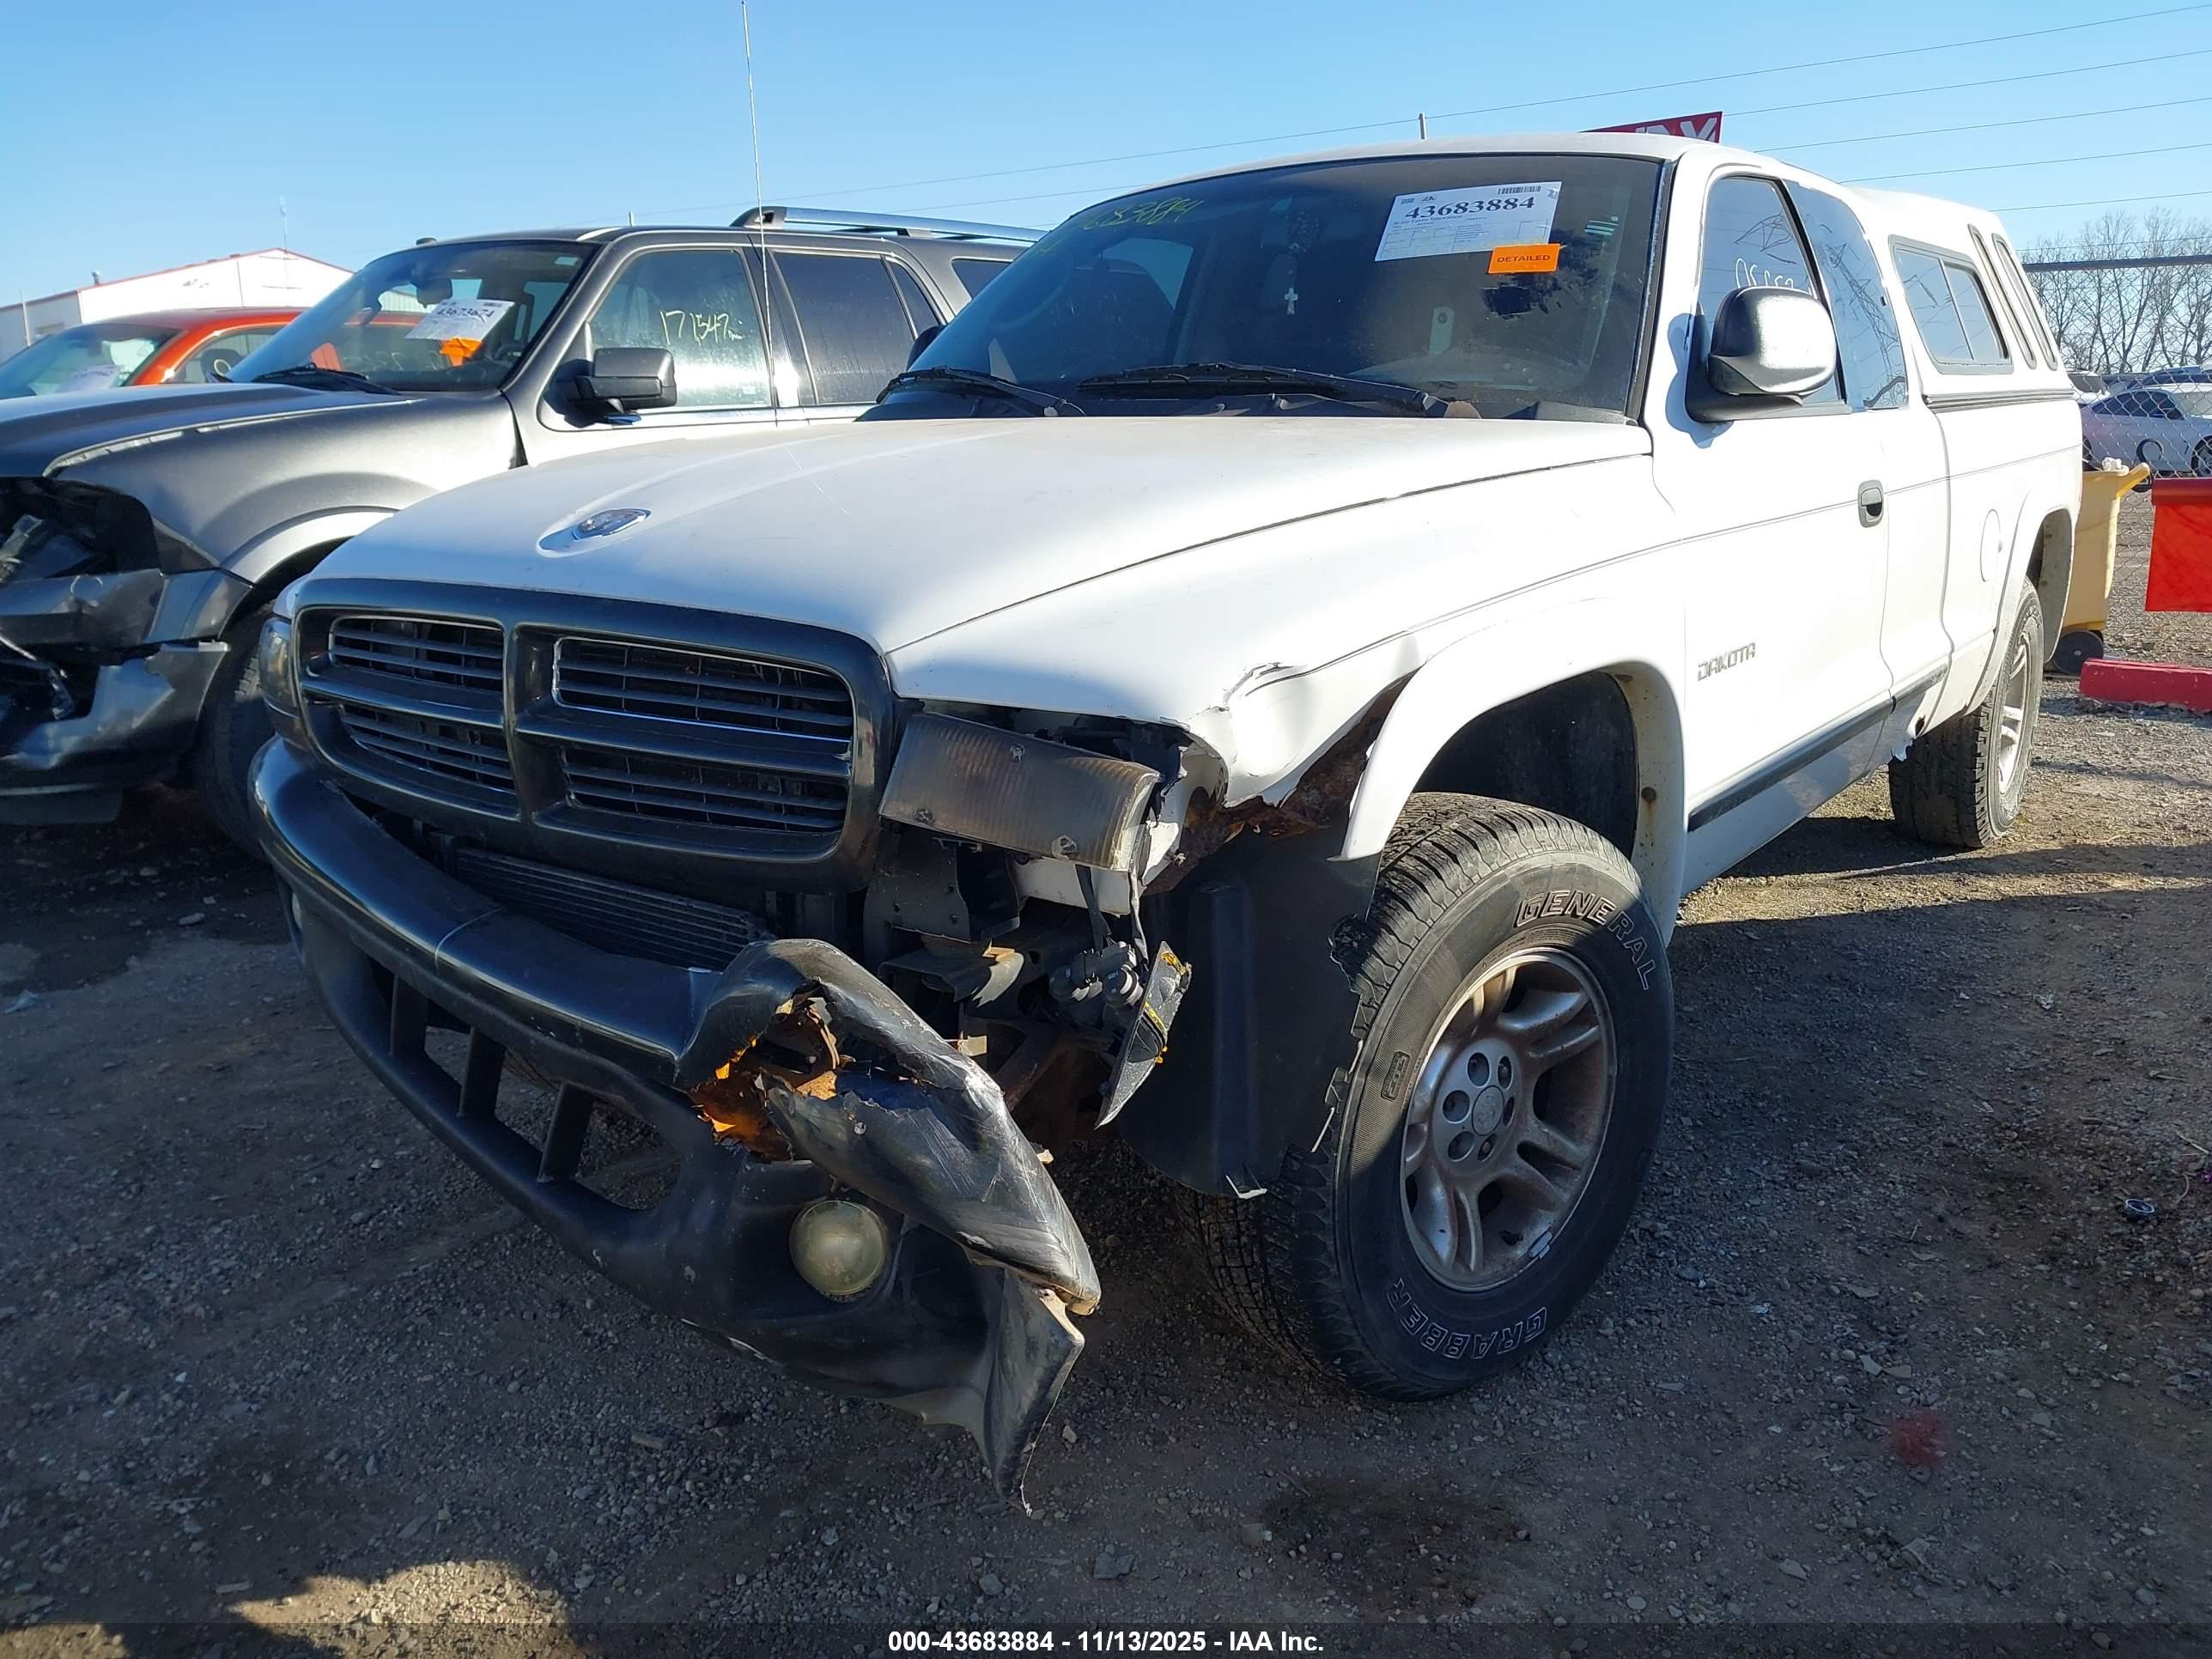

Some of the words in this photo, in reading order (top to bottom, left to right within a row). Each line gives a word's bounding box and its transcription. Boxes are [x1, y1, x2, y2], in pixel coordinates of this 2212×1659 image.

[1405, 195, 1535, 219] 43683884
[1497, 253, 1551, 264] DETAILED
[1698, 641, 1756, 681] DAKOTA
[1513, 890, 1656, 991] GENERAL
[1385, 1277, 1547, 1360] GRABBER
